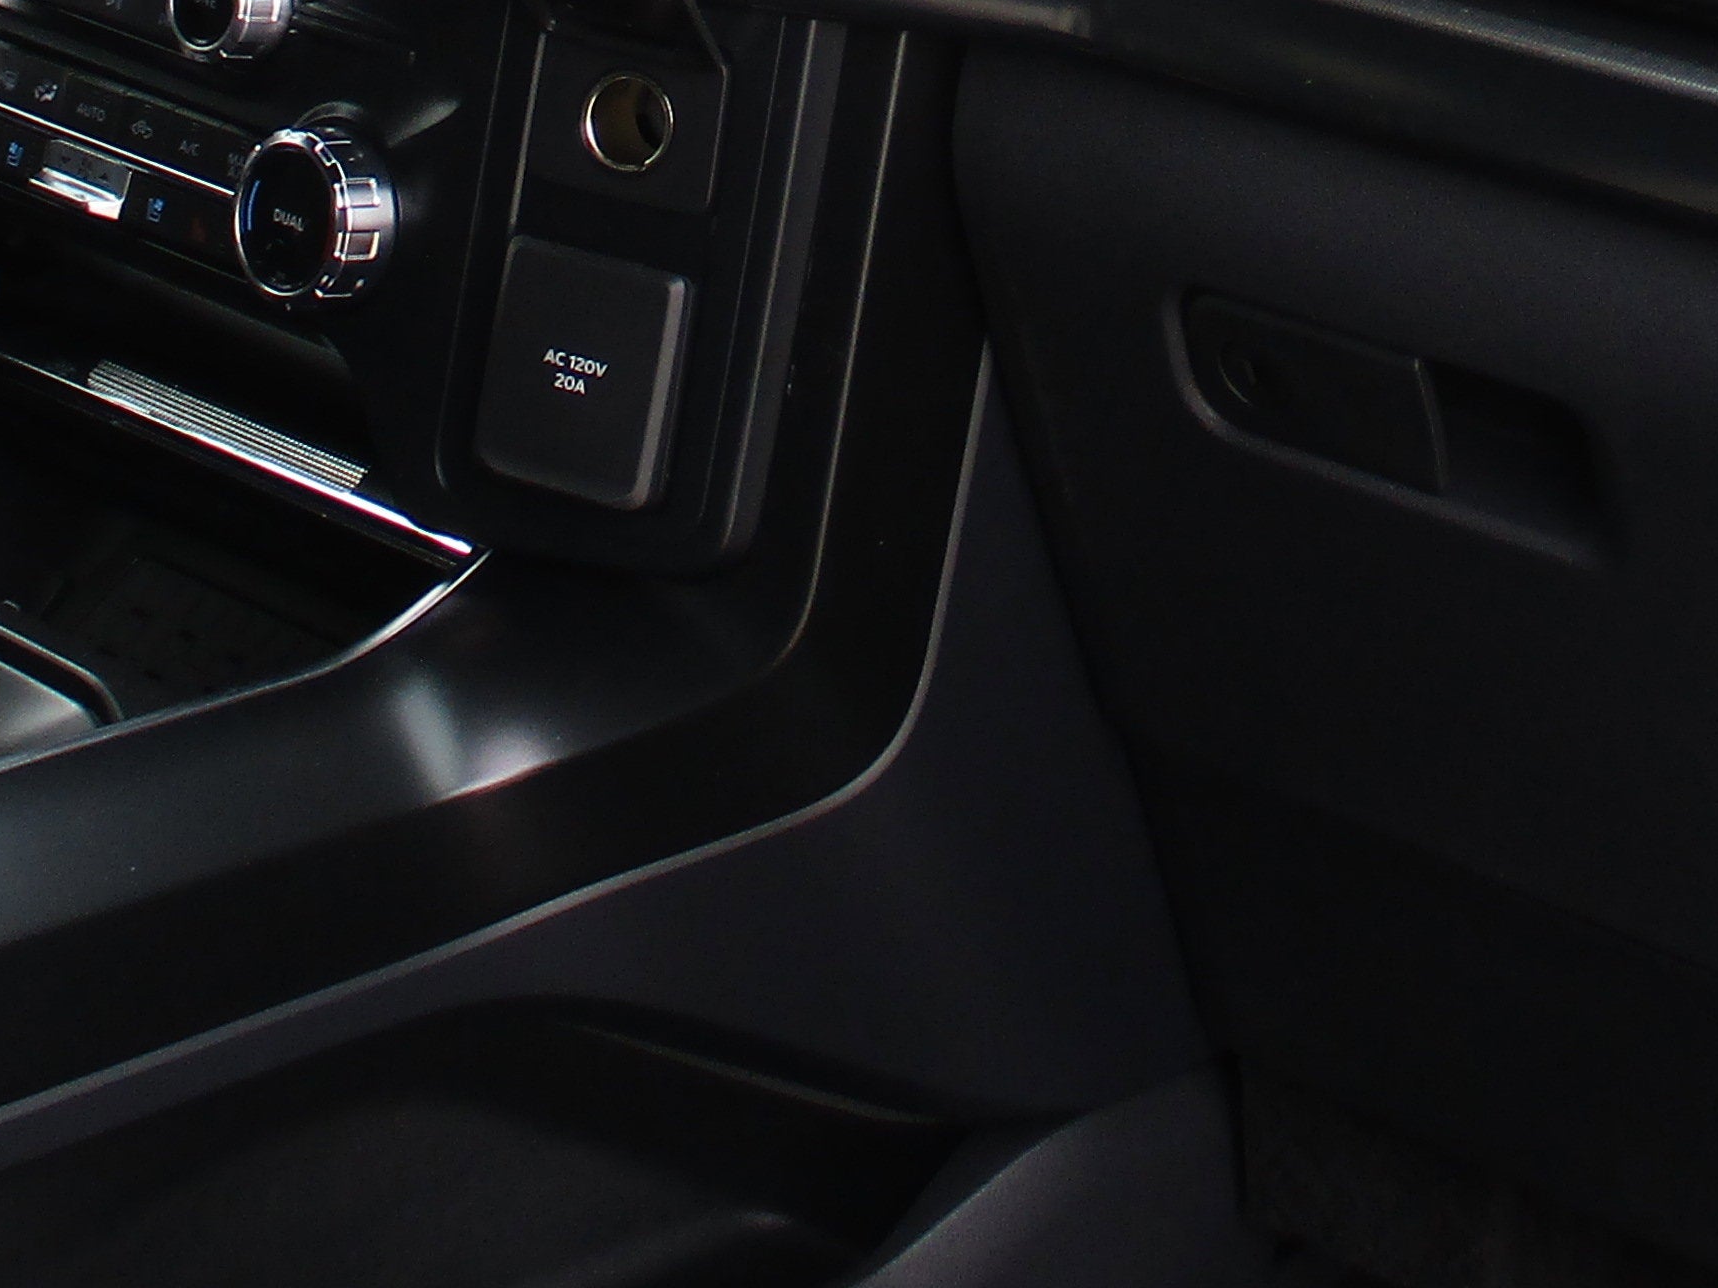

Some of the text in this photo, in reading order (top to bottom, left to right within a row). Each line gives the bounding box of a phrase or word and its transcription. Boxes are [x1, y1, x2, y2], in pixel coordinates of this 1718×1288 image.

[75, 102, 107, 123] AUTO
[273, 207, 304, 232] DUAL
[543, 349, 608, 377] AC 120V
[553, 373, 586, 394] 20A
